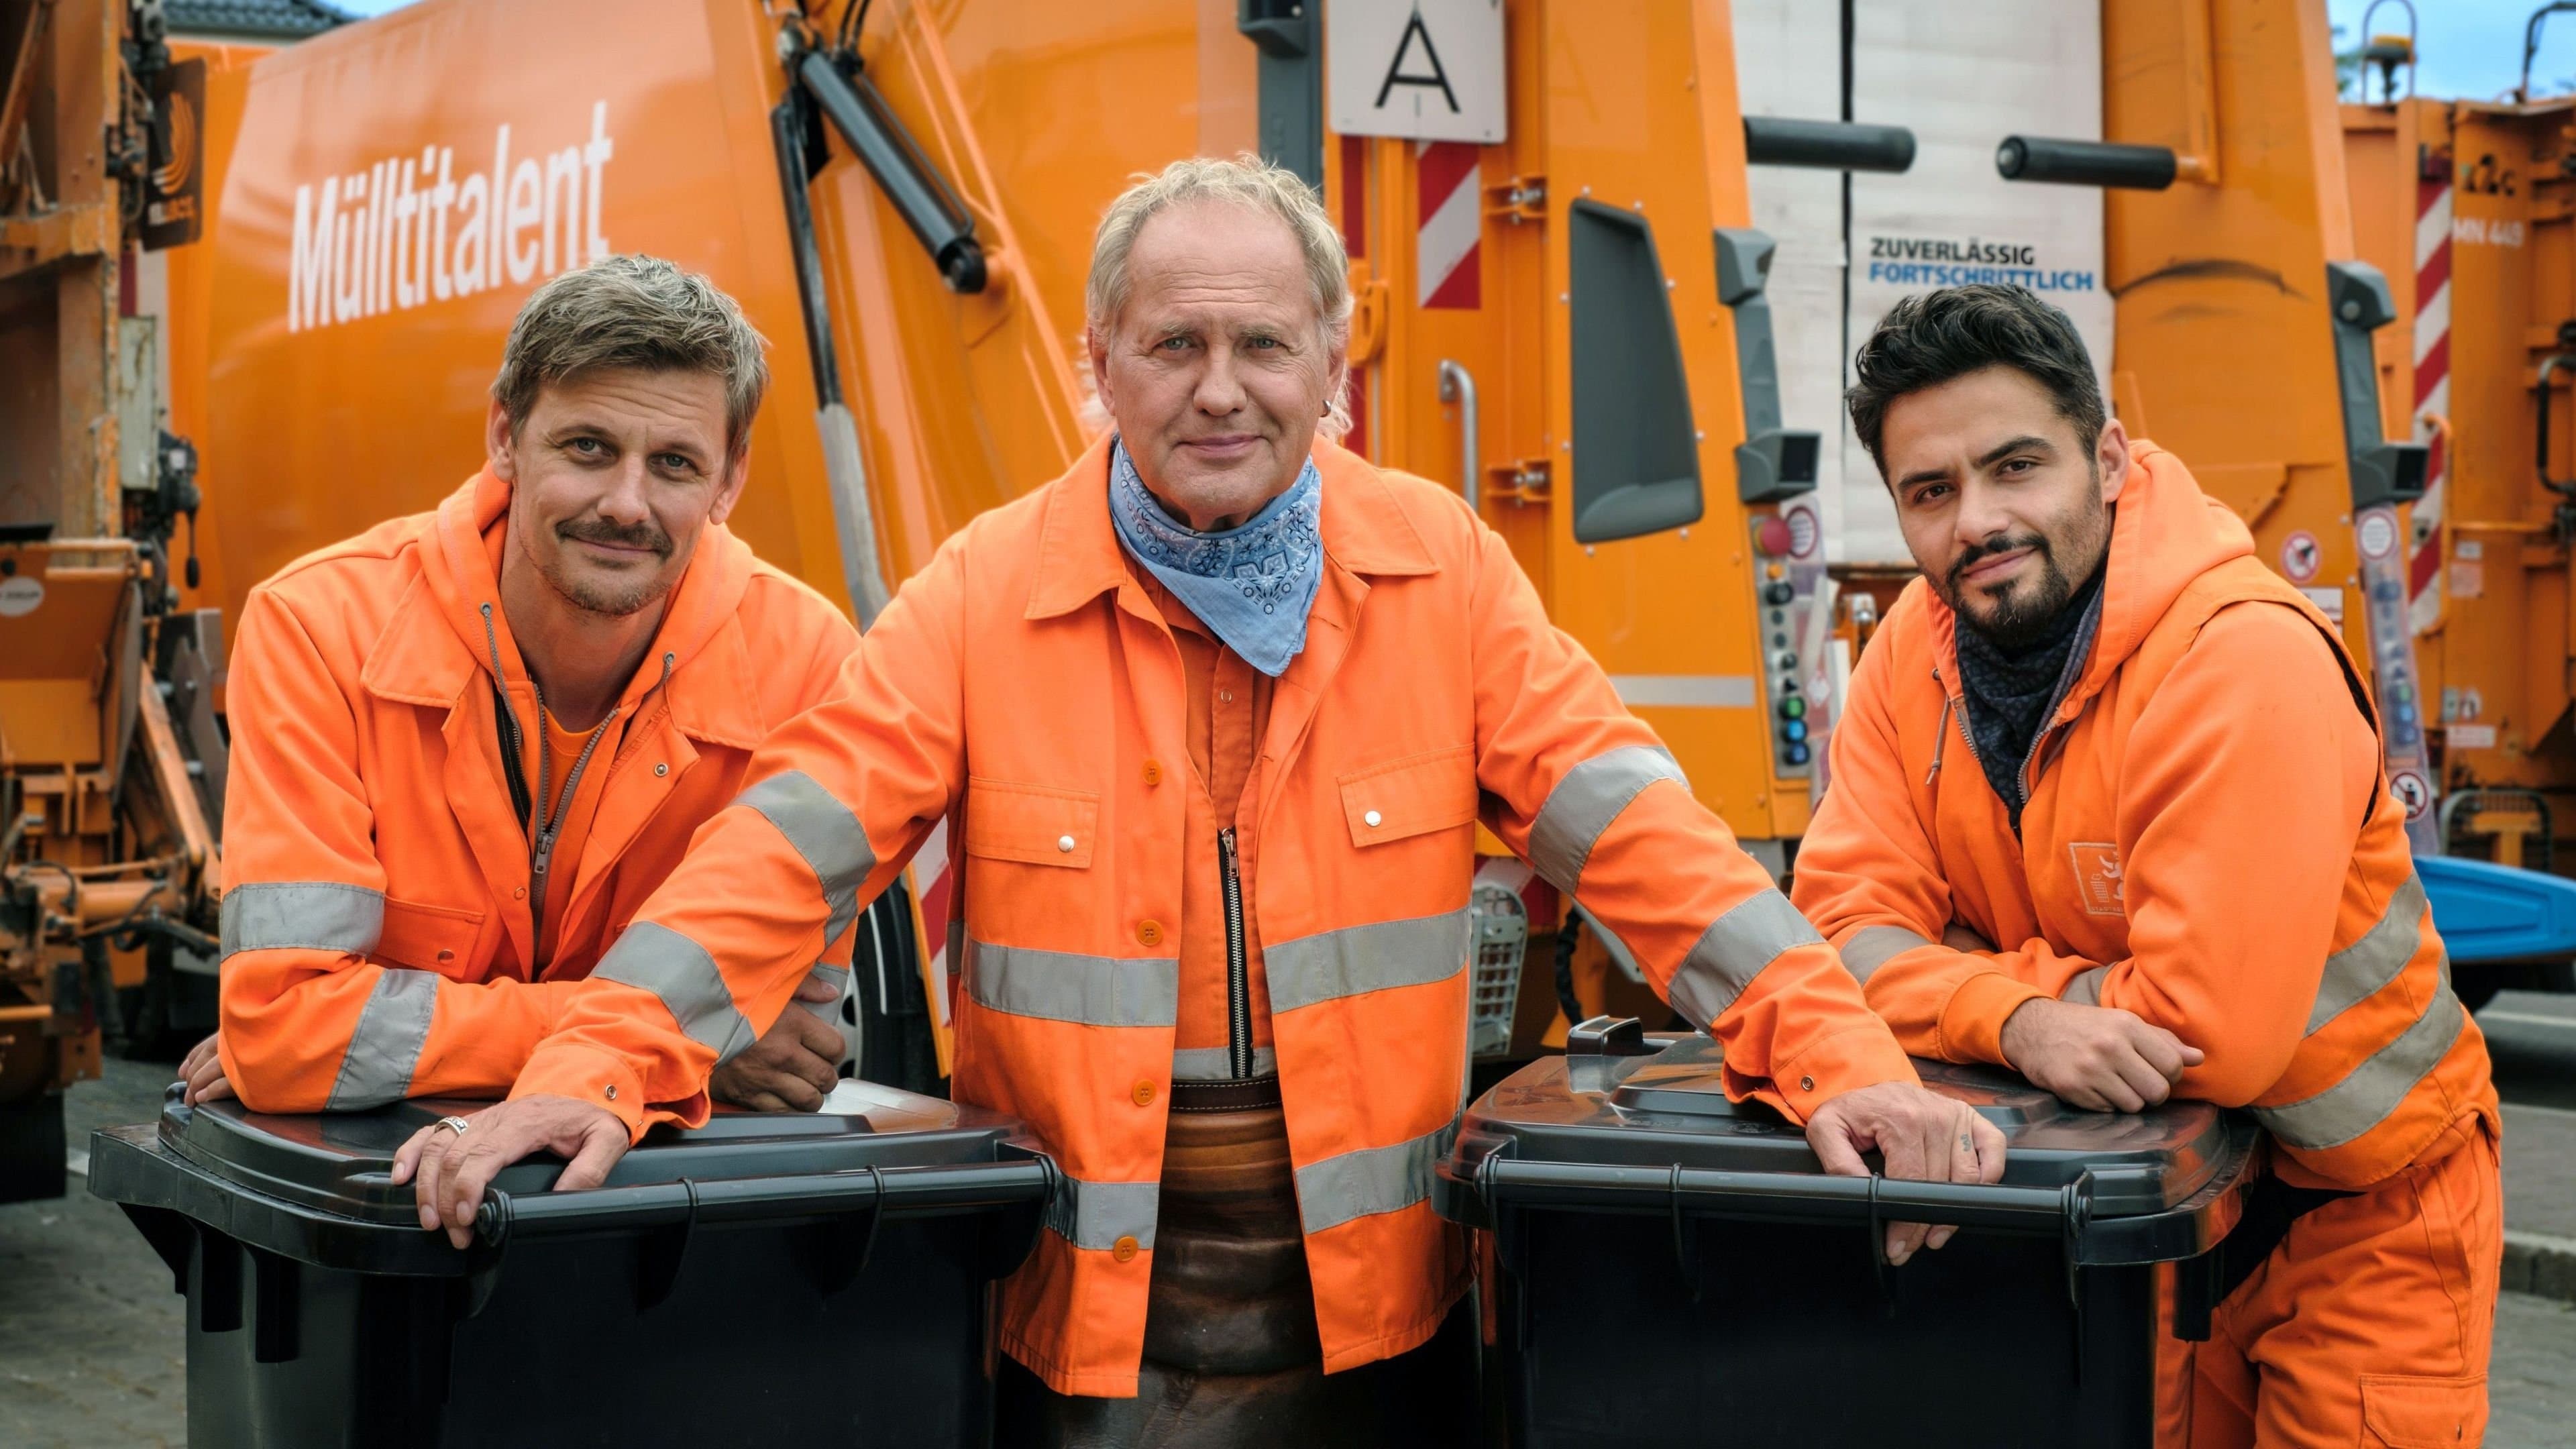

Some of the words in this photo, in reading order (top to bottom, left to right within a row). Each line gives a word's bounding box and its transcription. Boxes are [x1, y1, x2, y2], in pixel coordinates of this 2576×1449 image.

[1375, 7, 1460, 113] A
[288, 101, 612, 333] Mülltitalent
[1869, 262, 2093, 290] FORTSCHRITTLICH
[1870, 237, 2035, 266] ZUVERLÄSSIG
